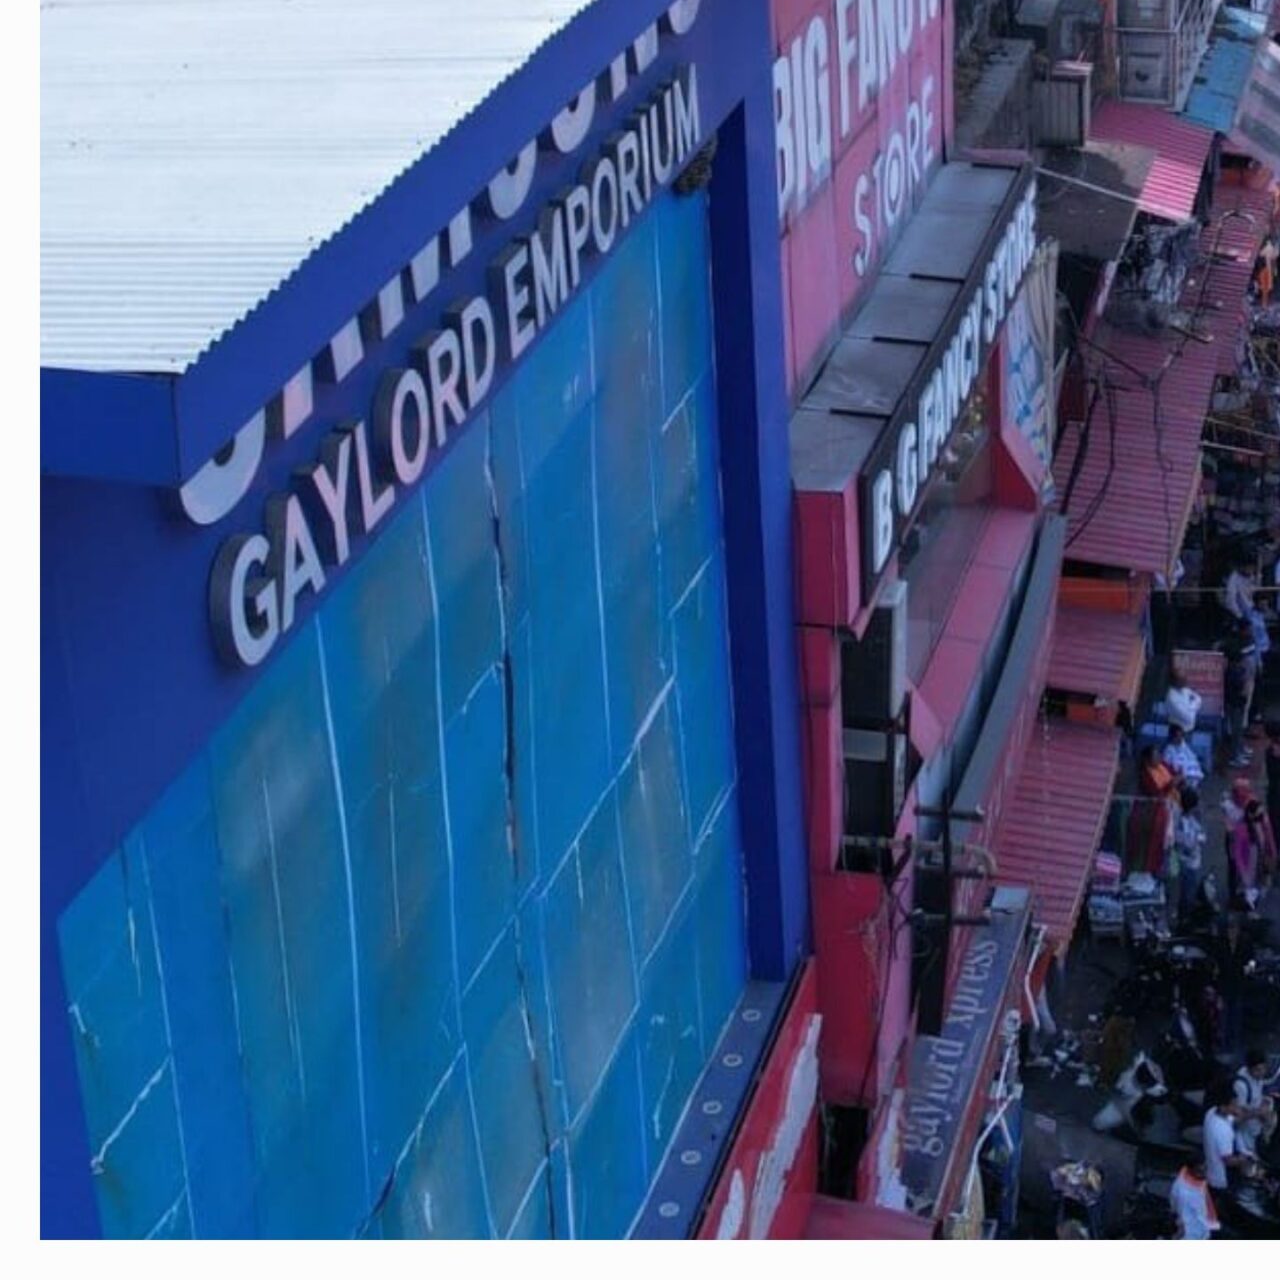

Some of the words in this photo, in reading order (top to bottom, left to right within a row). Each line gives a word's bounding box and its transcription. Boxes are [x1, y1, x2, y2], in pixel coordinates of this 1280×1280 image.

[773, 15, 832, 220] BIG
[853, 75, 935, 277] STORE
[218, 295, 496, 667] GAYLORD
[498, 63, 702, 360] EMPORIUM
[918, 287, 983, 480] FANCY
[983, 177, 1038, 345] STORE
